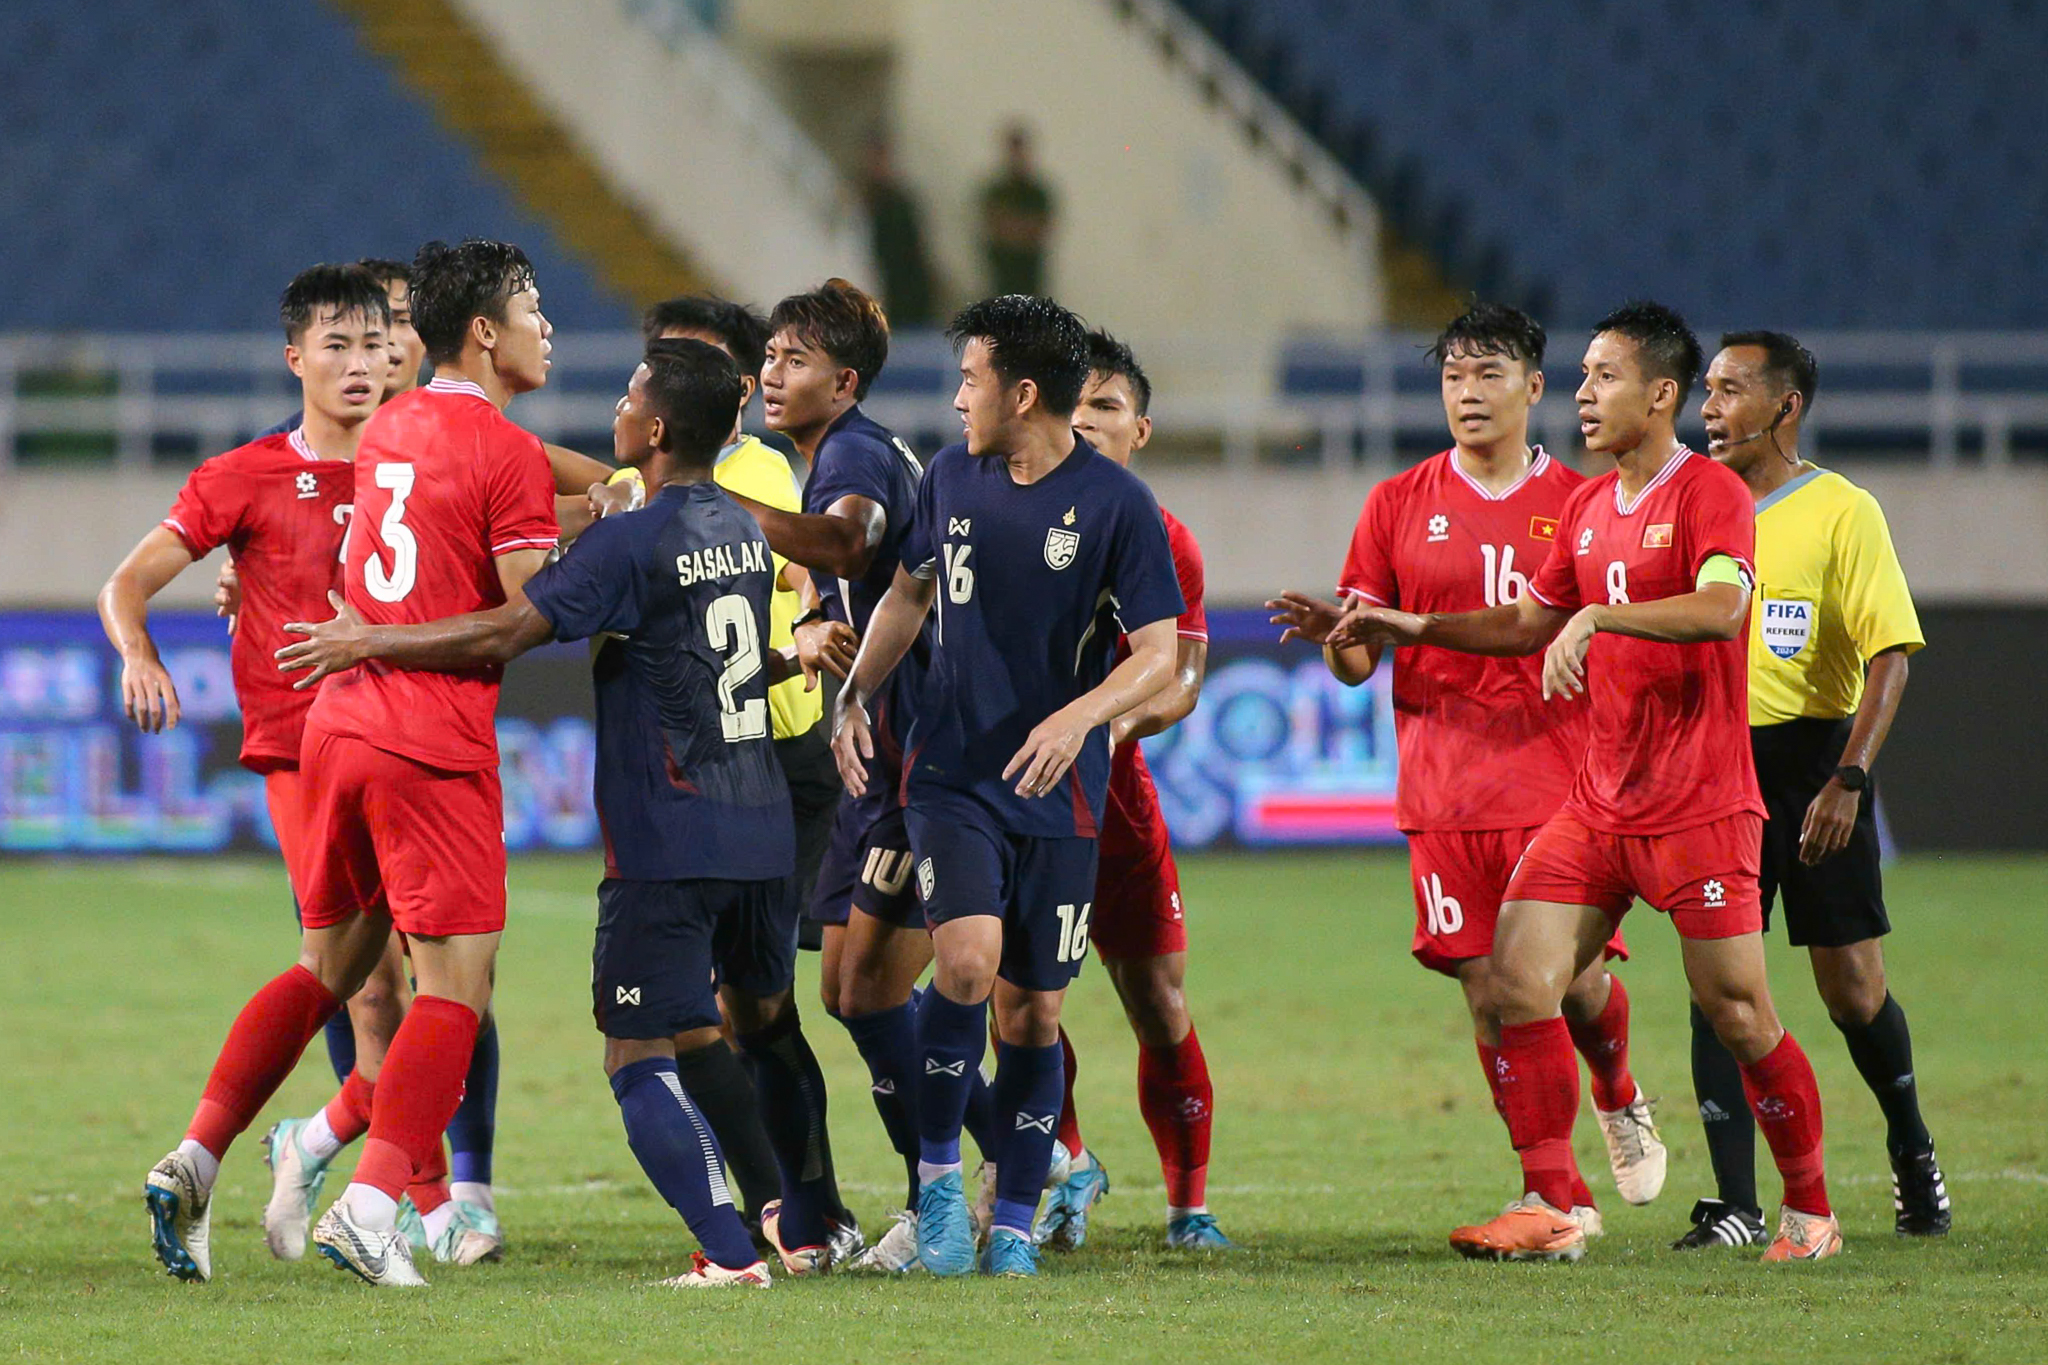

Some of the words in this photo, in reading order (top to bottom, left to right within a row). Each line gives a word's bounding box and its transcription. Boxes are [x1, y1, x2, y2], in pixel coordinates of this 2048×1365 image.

[363, 462, 419, 603] 3
[676, 540, 768, 588] SASALAK
[943, 542, 975, 605] 16
[1480, 544, 1528, 607] 16
[1765, 626, 1806, 638] REFEREE
[1767, 603, 1807, 620] FIFA
[705, 593, 767, 744] 2
[1775, 645, 1795, 656] 2024
[861, 846, 915, 897] 10
[1056, 902, 1092, 963] 16
[1421, 872, 1463, 936] 16
